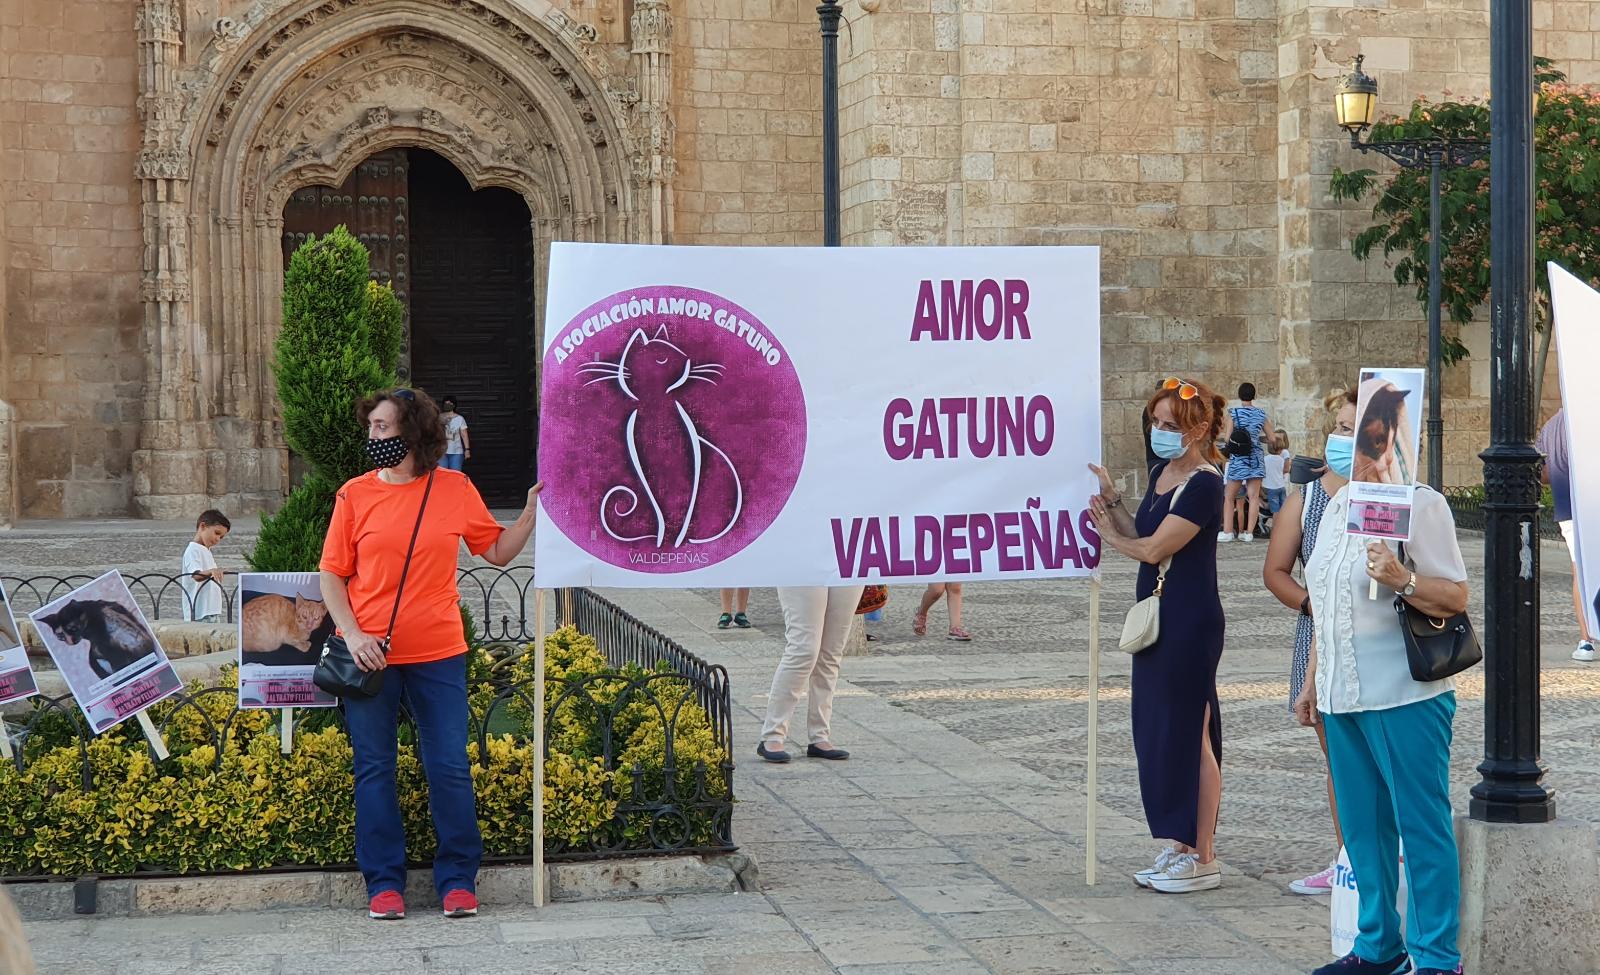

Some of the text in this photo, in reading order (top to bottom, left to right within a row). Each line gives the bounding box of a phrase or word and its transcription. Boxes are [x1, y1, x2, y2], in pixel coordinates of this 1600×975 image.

[553, 295, 781, 366] ASOCIACIÓN AMOR GATUNO
[910, 279, 1032, 341] AMOR
[883, 394, 1055, 460] GATUNO
[629, 549, 709, 564] VALDEPEÑAS
[831, 496, 1101, 578] VALDEPEÑAS
